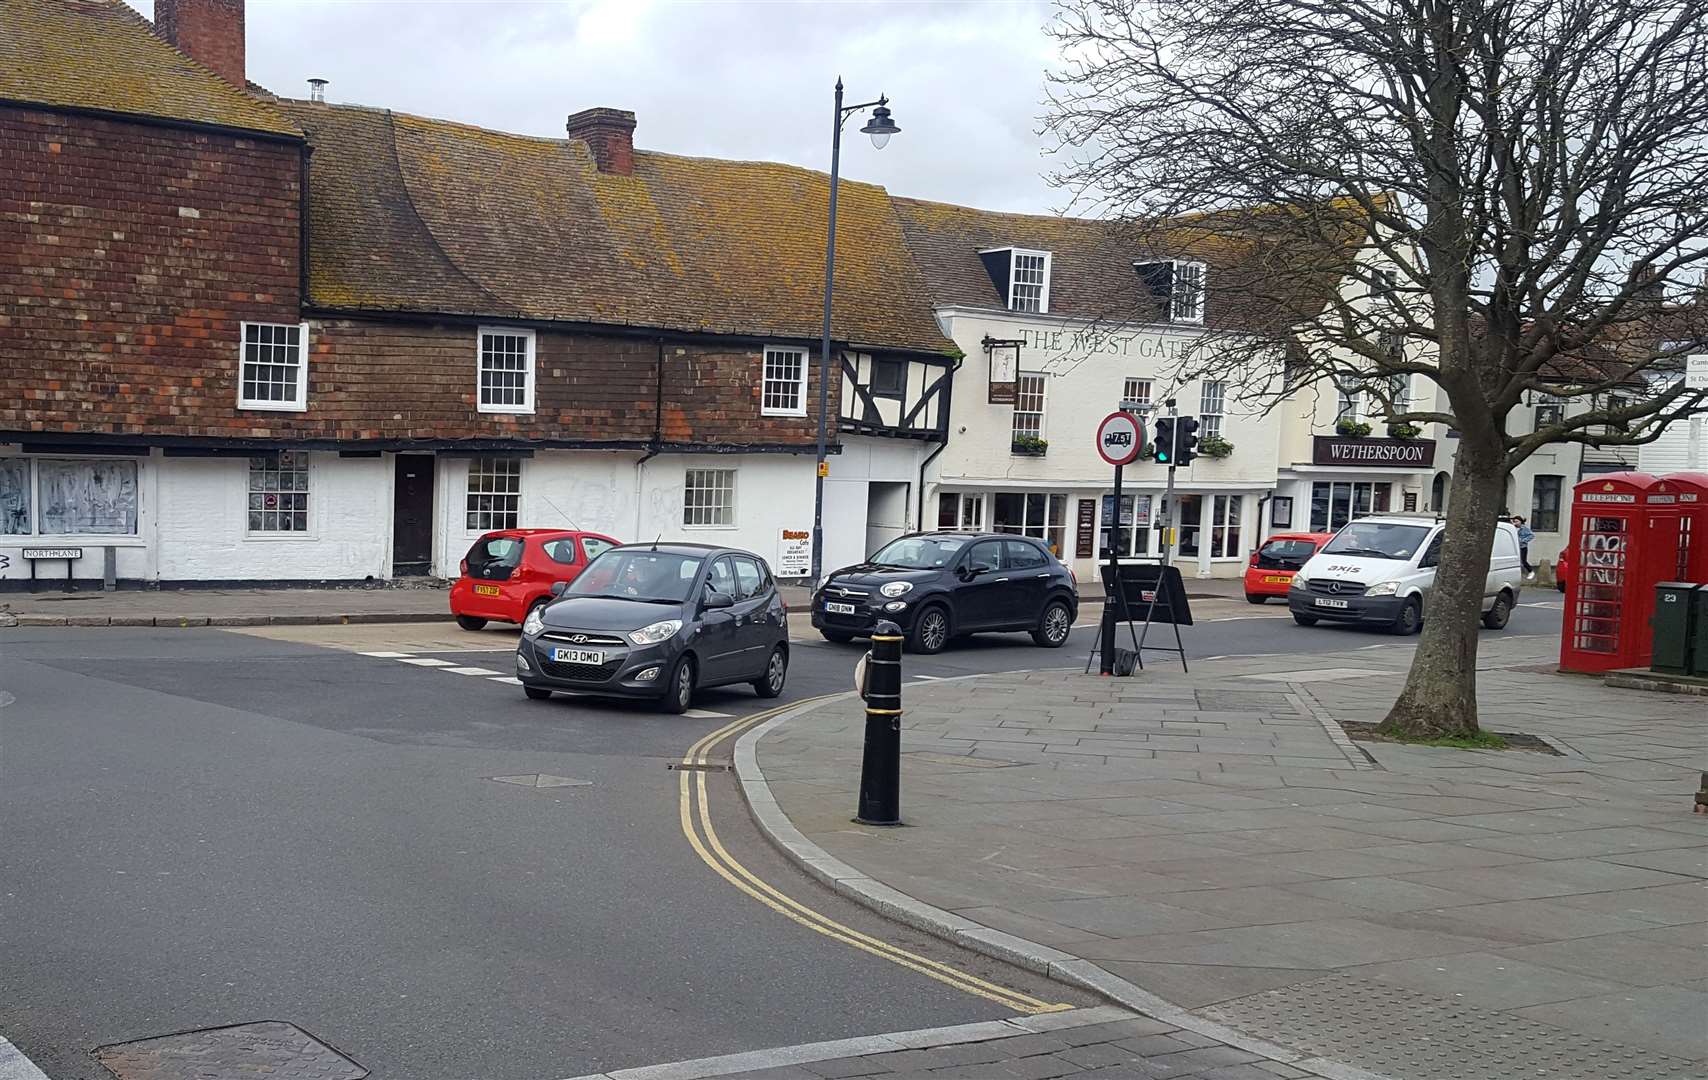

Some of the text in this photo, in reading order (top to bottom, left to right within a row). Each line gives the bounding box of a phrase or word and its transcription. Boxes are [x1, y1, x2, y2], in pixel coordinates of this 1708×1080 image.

[1019, 329, 1062, 350] THE
[1073, 333, 1132, 355] WEST
[1140, 336, 1191, 359] GATE
[1331, 444, 1424, 461] WETHERSPOON
[26, 549, 79, 557] NORTH LANE
[1327, 565, 1362, 573] axis
[1664, 594, 1677, 602] 23
[557, 650, 599, 662] GK13 OMO
